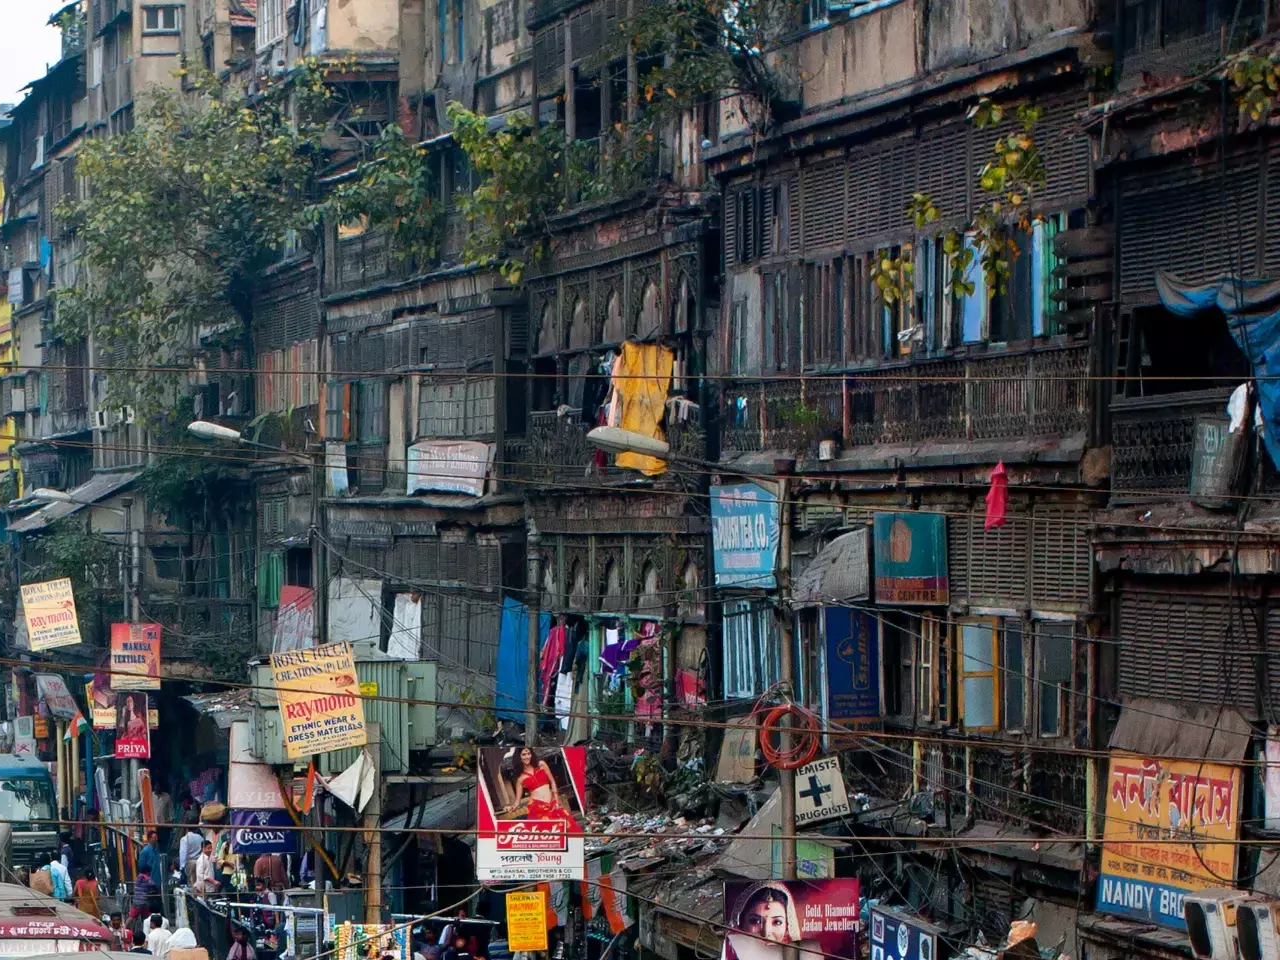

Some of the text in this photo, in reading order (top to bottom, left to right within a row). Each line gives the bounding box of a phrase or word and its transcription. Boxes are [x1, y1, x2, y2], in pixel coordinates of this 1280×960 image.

[755, 513, 768, 548] CO.
[898, 588, 937, 601] CENTRE
[30, 609, 73, 629] Raymond
[122, 643, 151, 651] MANASA
[114, 655, 146, 663] TEXTILES
[273, 651, 309, 668] ROYAL
[275, 667, 323, 682] CREATIONS
[285, 689, 356, 721] Raymond
[288, 722, 363, 742] DRESS MATERIALS
[291, 721, 322, 732] ETHNIC
[324, 715, 347, 726] WEAR
[117, 742, 146, 753] PRIYA
[796, 803, 848, 822] DRUGGISTS
[236, 829, 285, 846] CROWN
[498, 823, 561, 844] Ashok
[535, 853, 562, 865] Young
[1102, 879, 1154, 919] NANDY
[805, 903, 855, 917] Gold, Diamond
[802, 919, 860, 932] Jadau Jewellery
